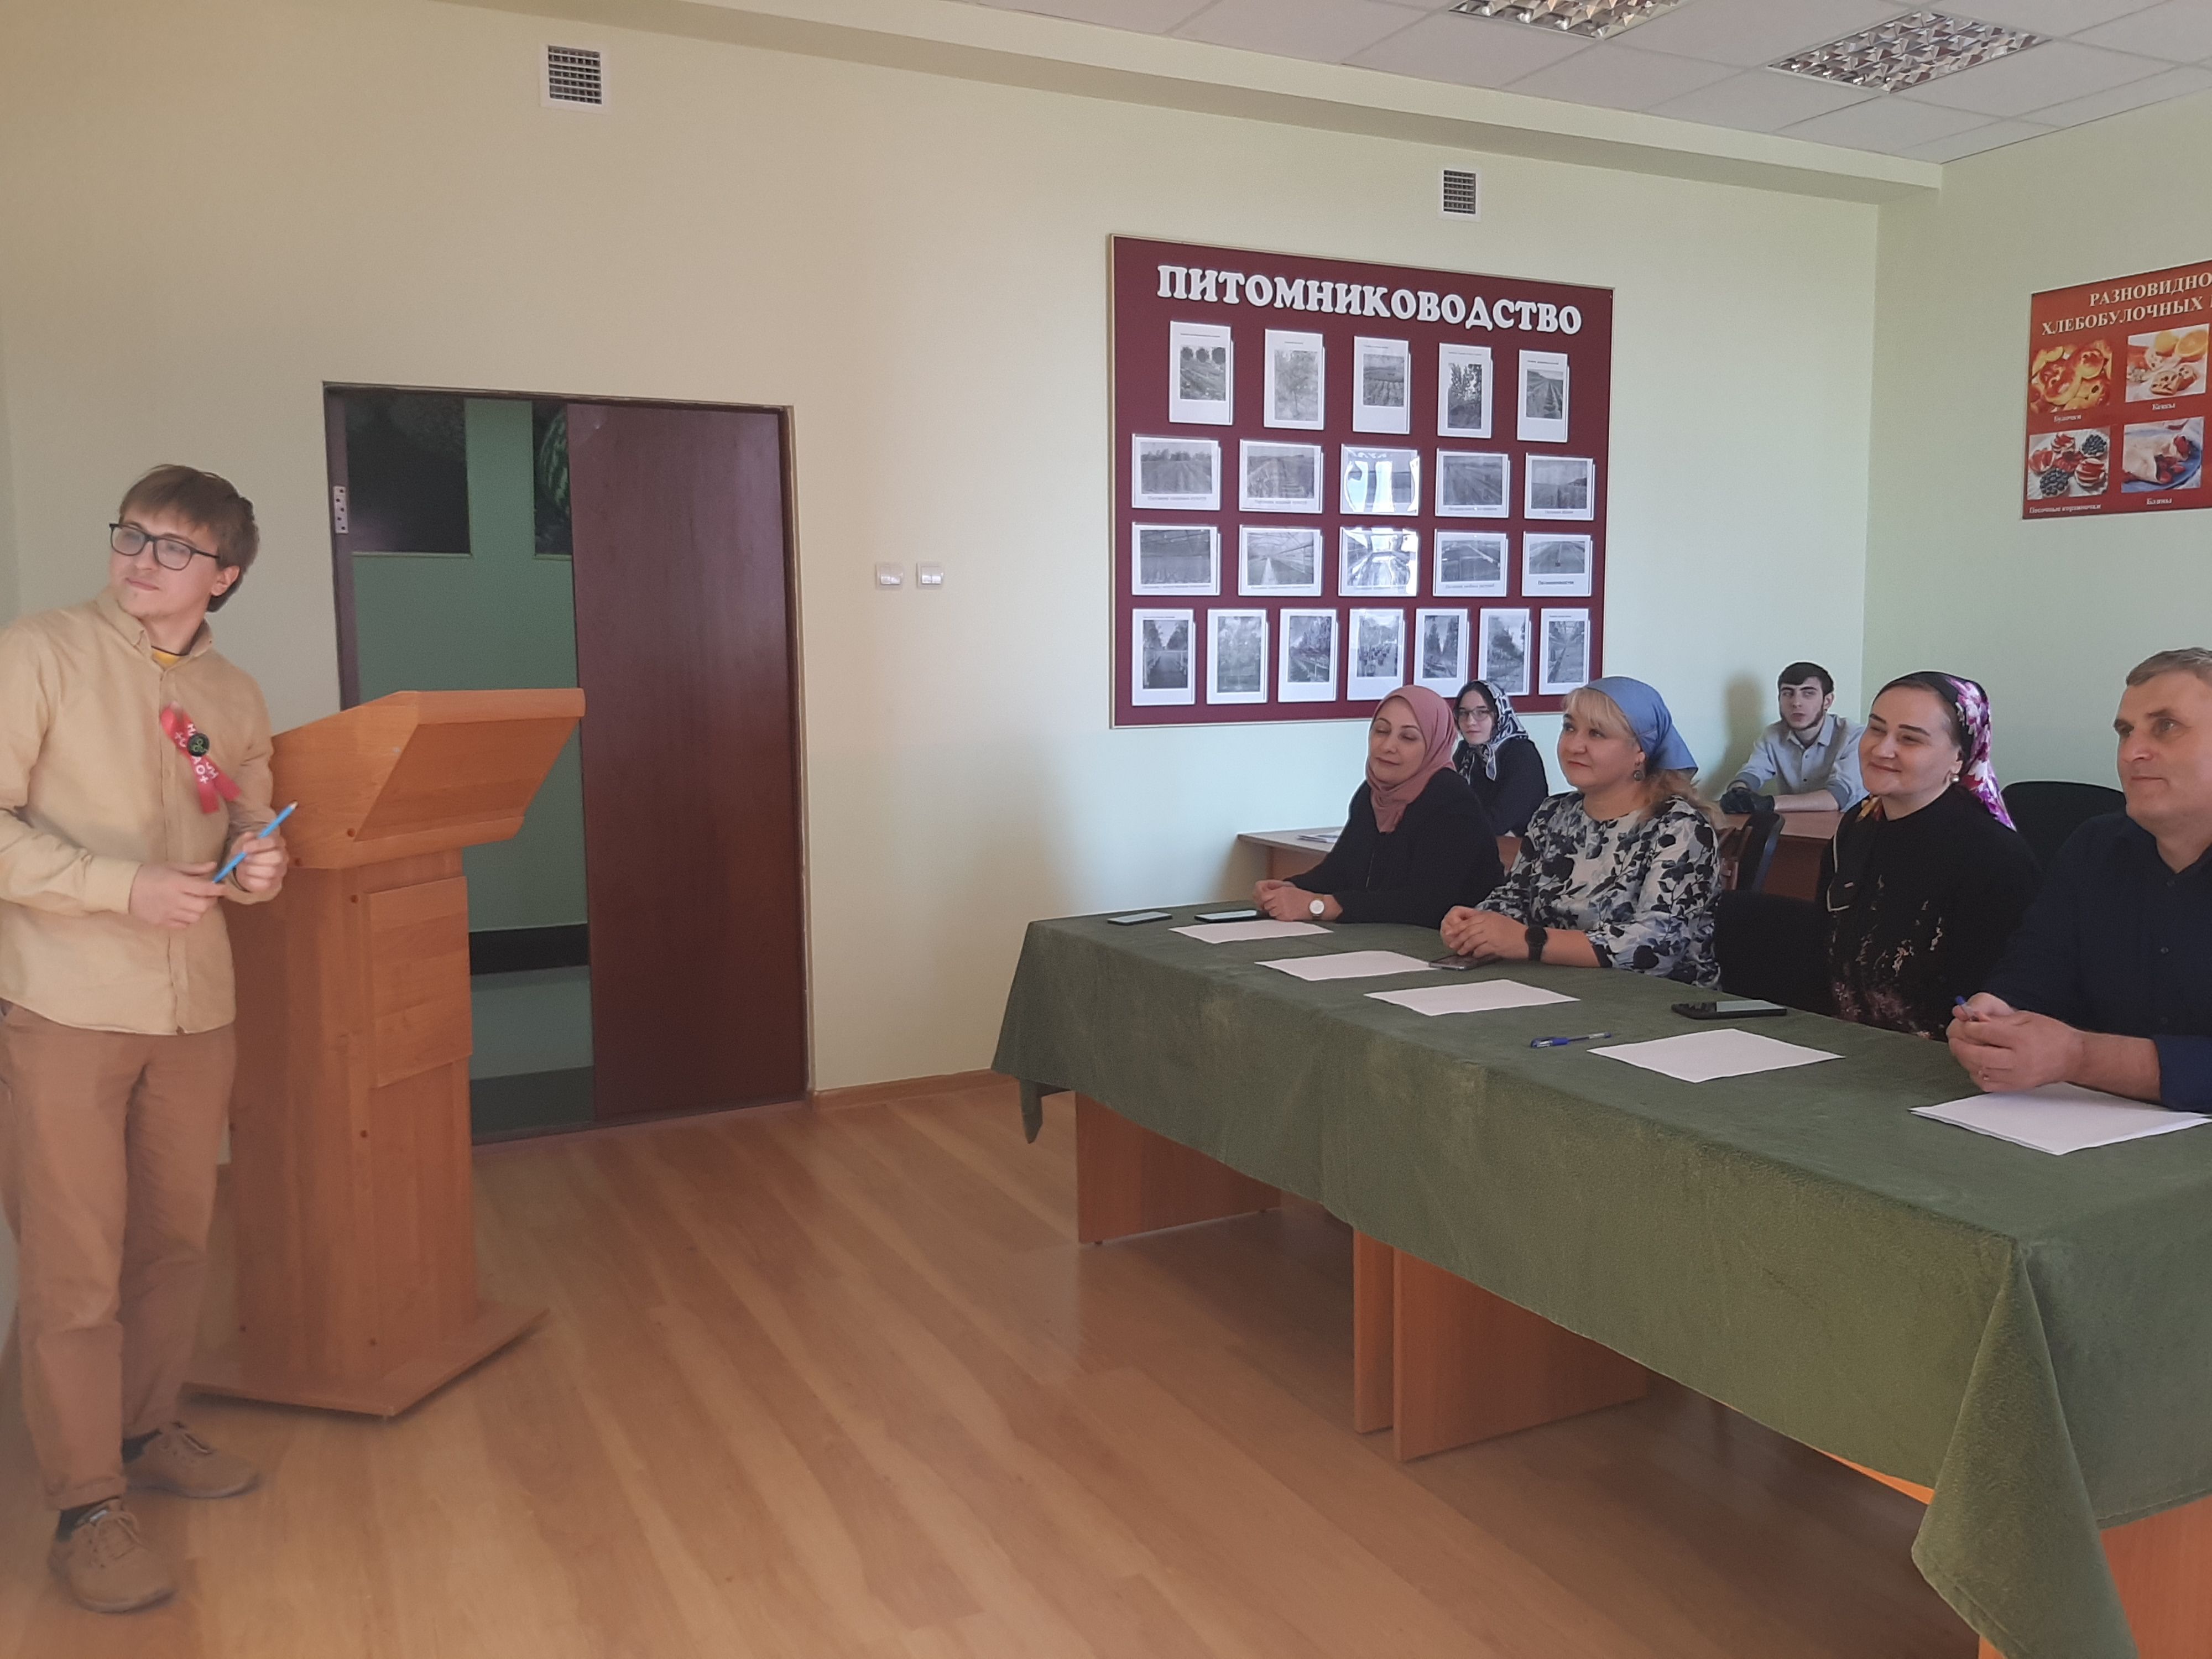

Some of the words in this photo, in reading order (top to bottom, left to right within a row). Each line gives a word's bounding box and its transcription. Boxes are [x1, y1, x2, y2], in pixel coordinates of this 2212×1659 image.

[1157, 265, 1582, 335] ПИТОМНИКОВОДСТВО
[2090, 273, 2212, 306] РАЗНОВИДНО
[2042, 296, 2204, 335] ХЛЕБОБУЛОЧНЫХ
